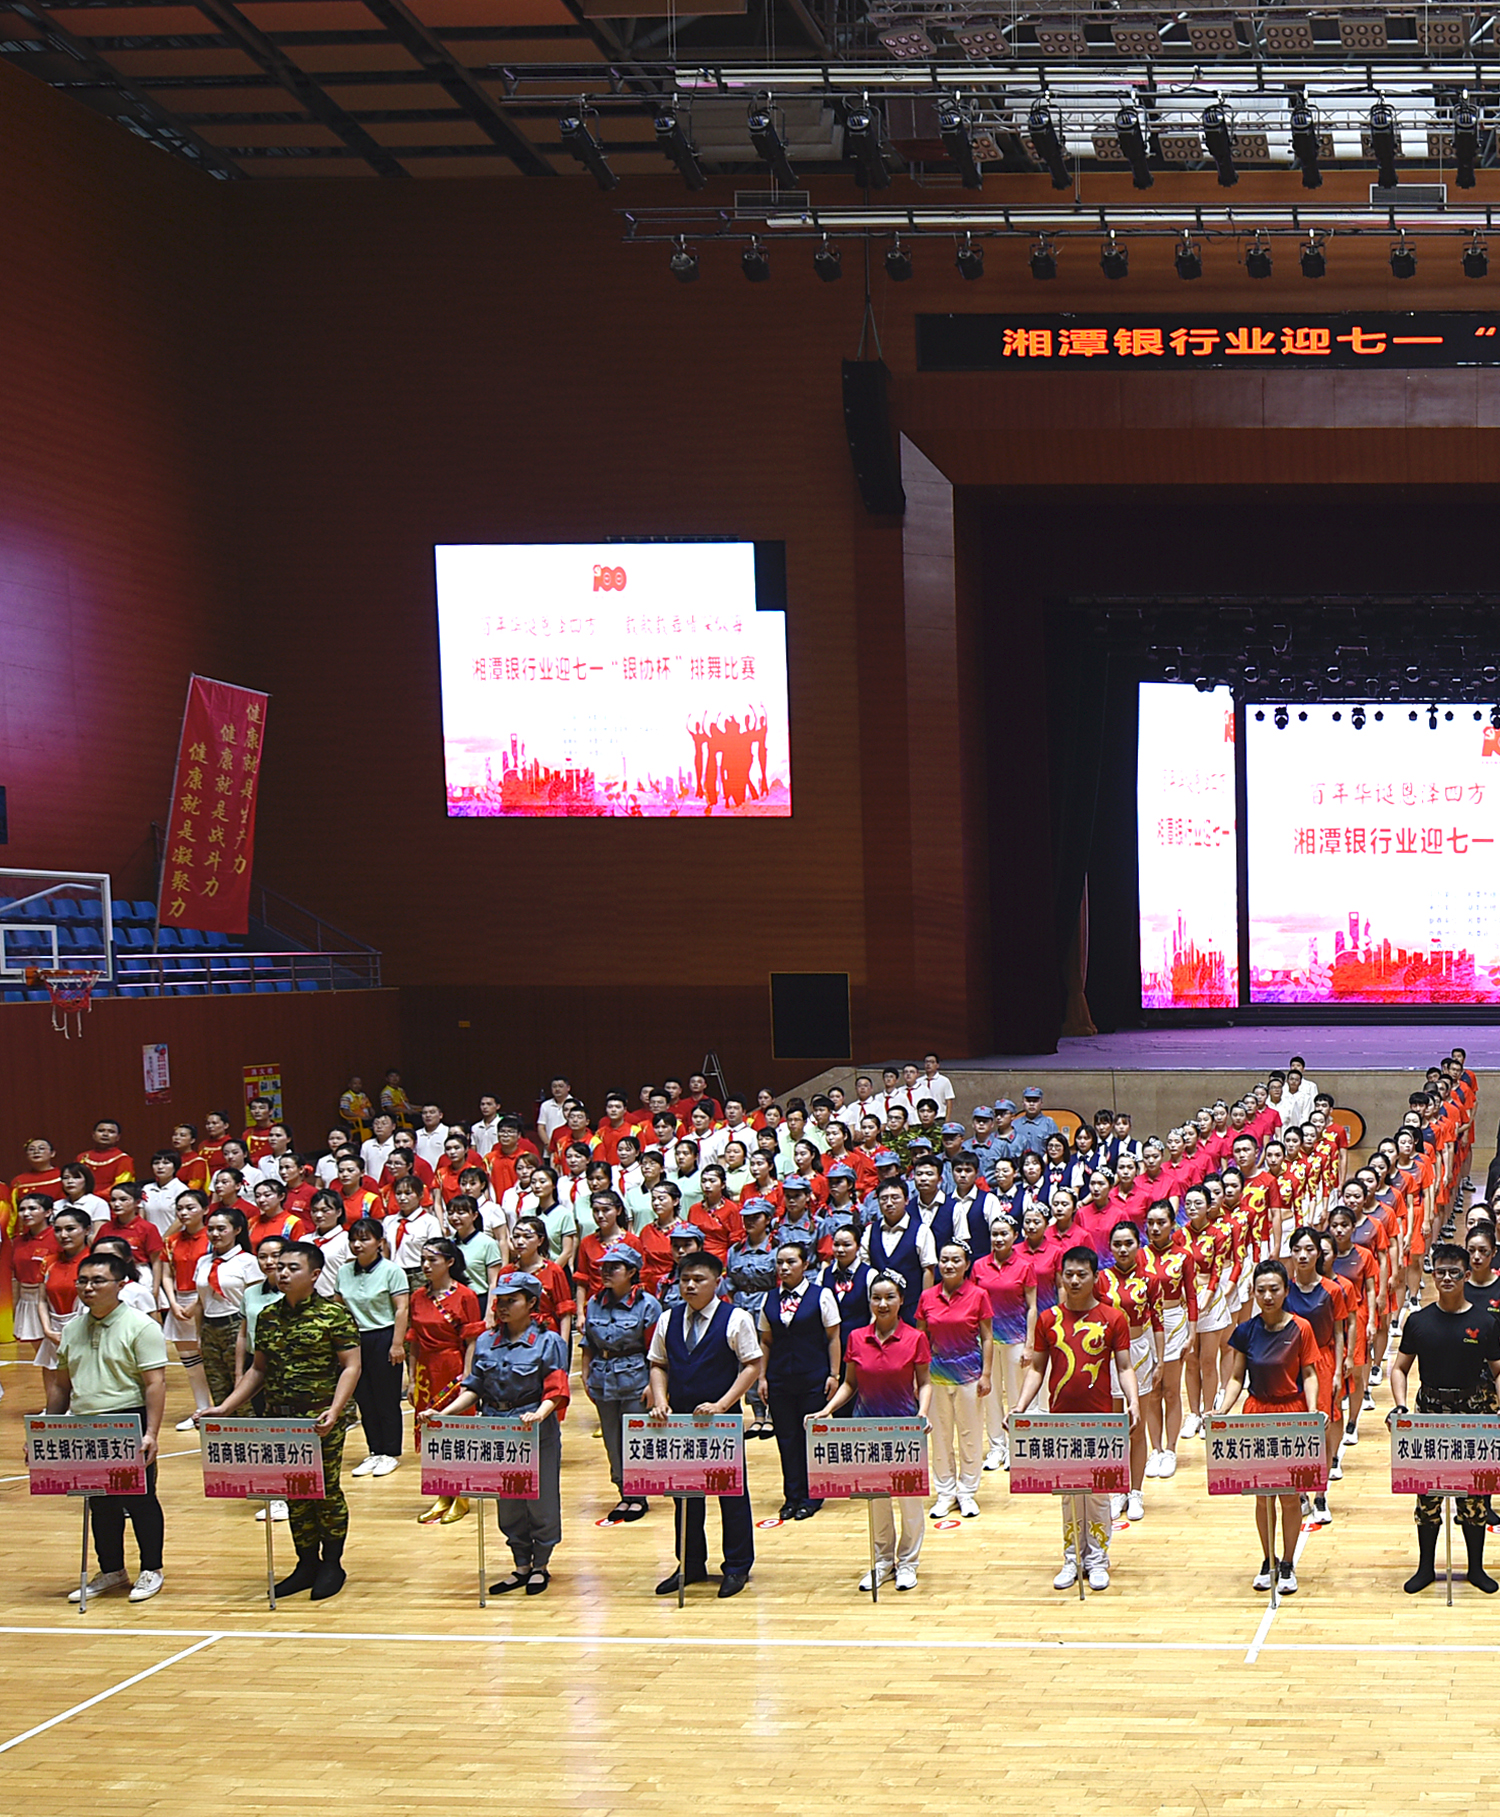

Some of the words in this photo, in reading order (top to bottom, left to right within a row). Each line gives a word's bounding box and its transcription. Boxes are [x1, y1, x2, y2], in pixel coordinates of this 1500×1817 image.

[234, 703, 263, 875] 健康就是生产力
[200, 723, 238, 897] 健康就是战斗力
[168, 741, 209, 918] 健康就是凝聚力
[33, 1438, 136, 1462] 民生银行湘潭支行
[208, 1441, 314, 1465] 招商银行湘潭分行
[428, 1438, 532, 1463] 中信银行湘潭分行
[629, 1438, 736, 1461] 交通银行湘潭分行
[814, 1441, 921, 1464] 中国银行湘潭分行
[1015, 1437, 1125, 1461] 工商银行湘潭分行
[1212, 1436, 1321, 1460] 农发行湘潭市分行
